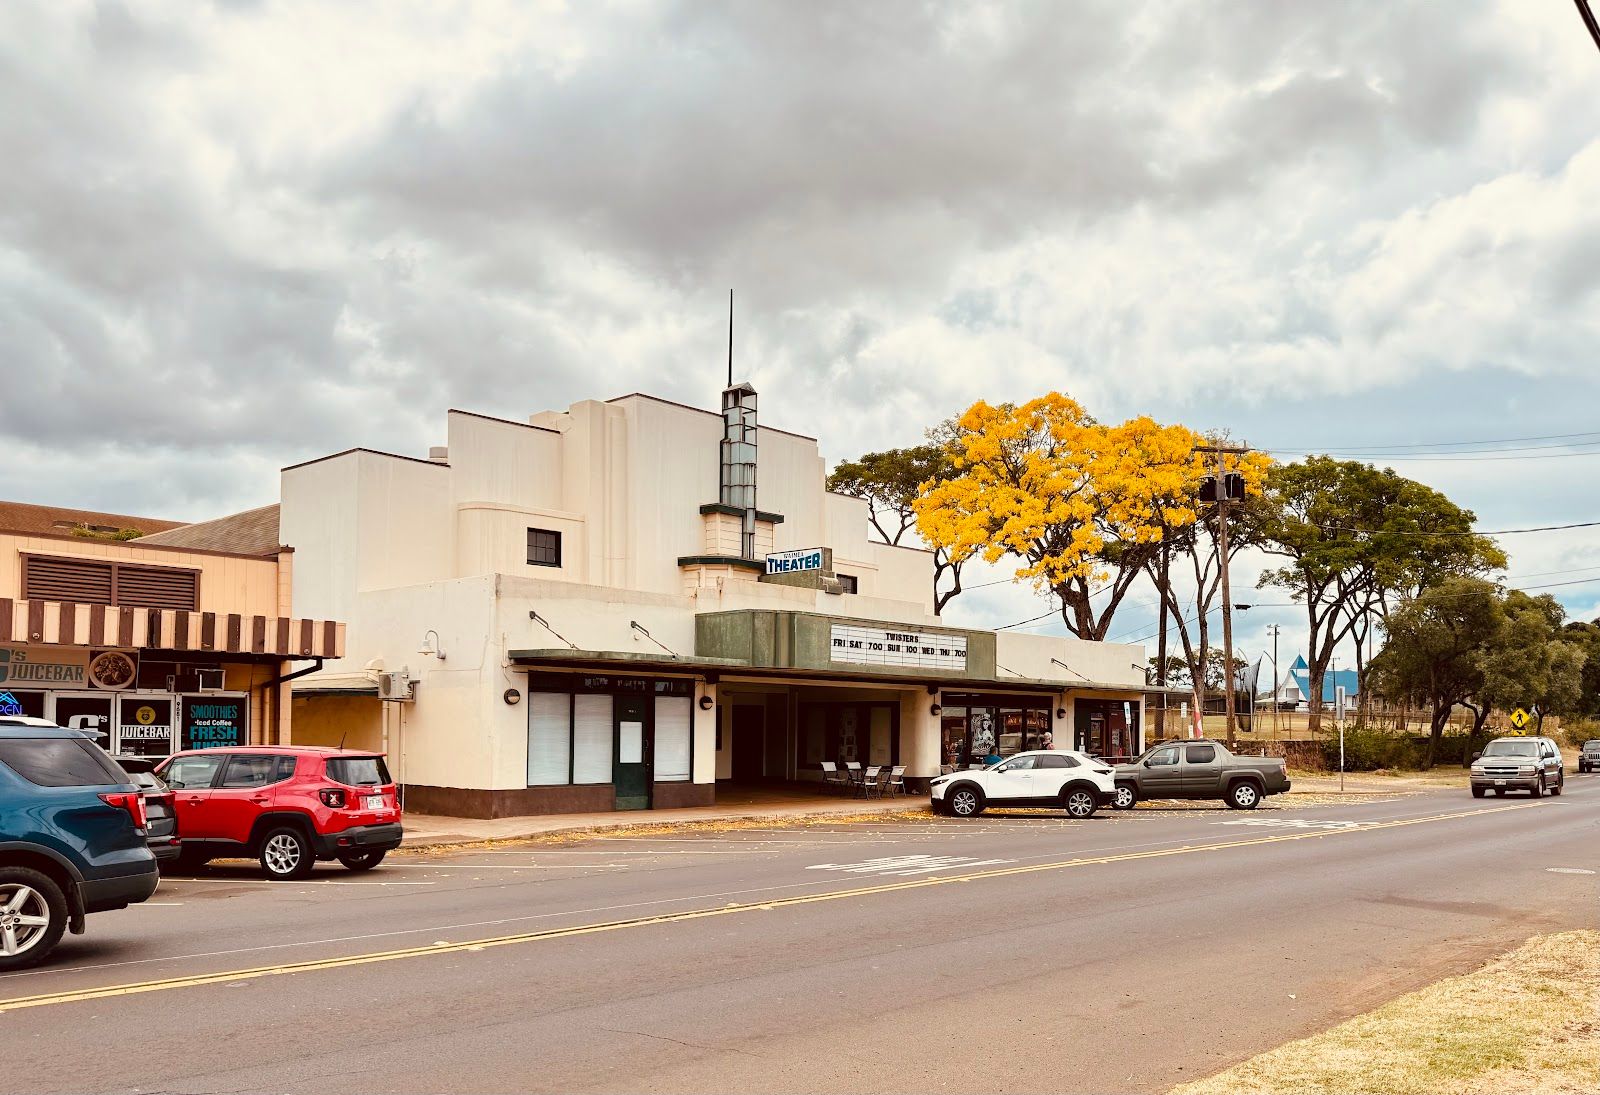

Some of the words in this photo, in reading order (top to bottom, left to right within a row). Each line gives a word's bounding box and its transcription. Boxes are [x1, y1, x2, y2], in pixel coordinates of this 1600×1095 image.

[767, 552, 821, 573] THEATER
[886, 632, 919, 643] TWISTERS
[833, 638, 846, 648] FRI
[849, 640, 863, 649] SAT
[868, 642, 883, 651] 700
[887, 644, 901, 653] SUN
[906, 645, 918, 654] 100
[921, 646, 935, 655] WED
[940, 648, 950, 657] THU
[954, 649, 967, 658] 700
[10, 664, 84, 680] JUICEBAR
[190, 704, 238, 719] SMOOTHIES
[211, 719, 232, 727] Coffee
[120, 726, 170, 739] JUICEBAR
[189, 726, 237, 740] FRESH
